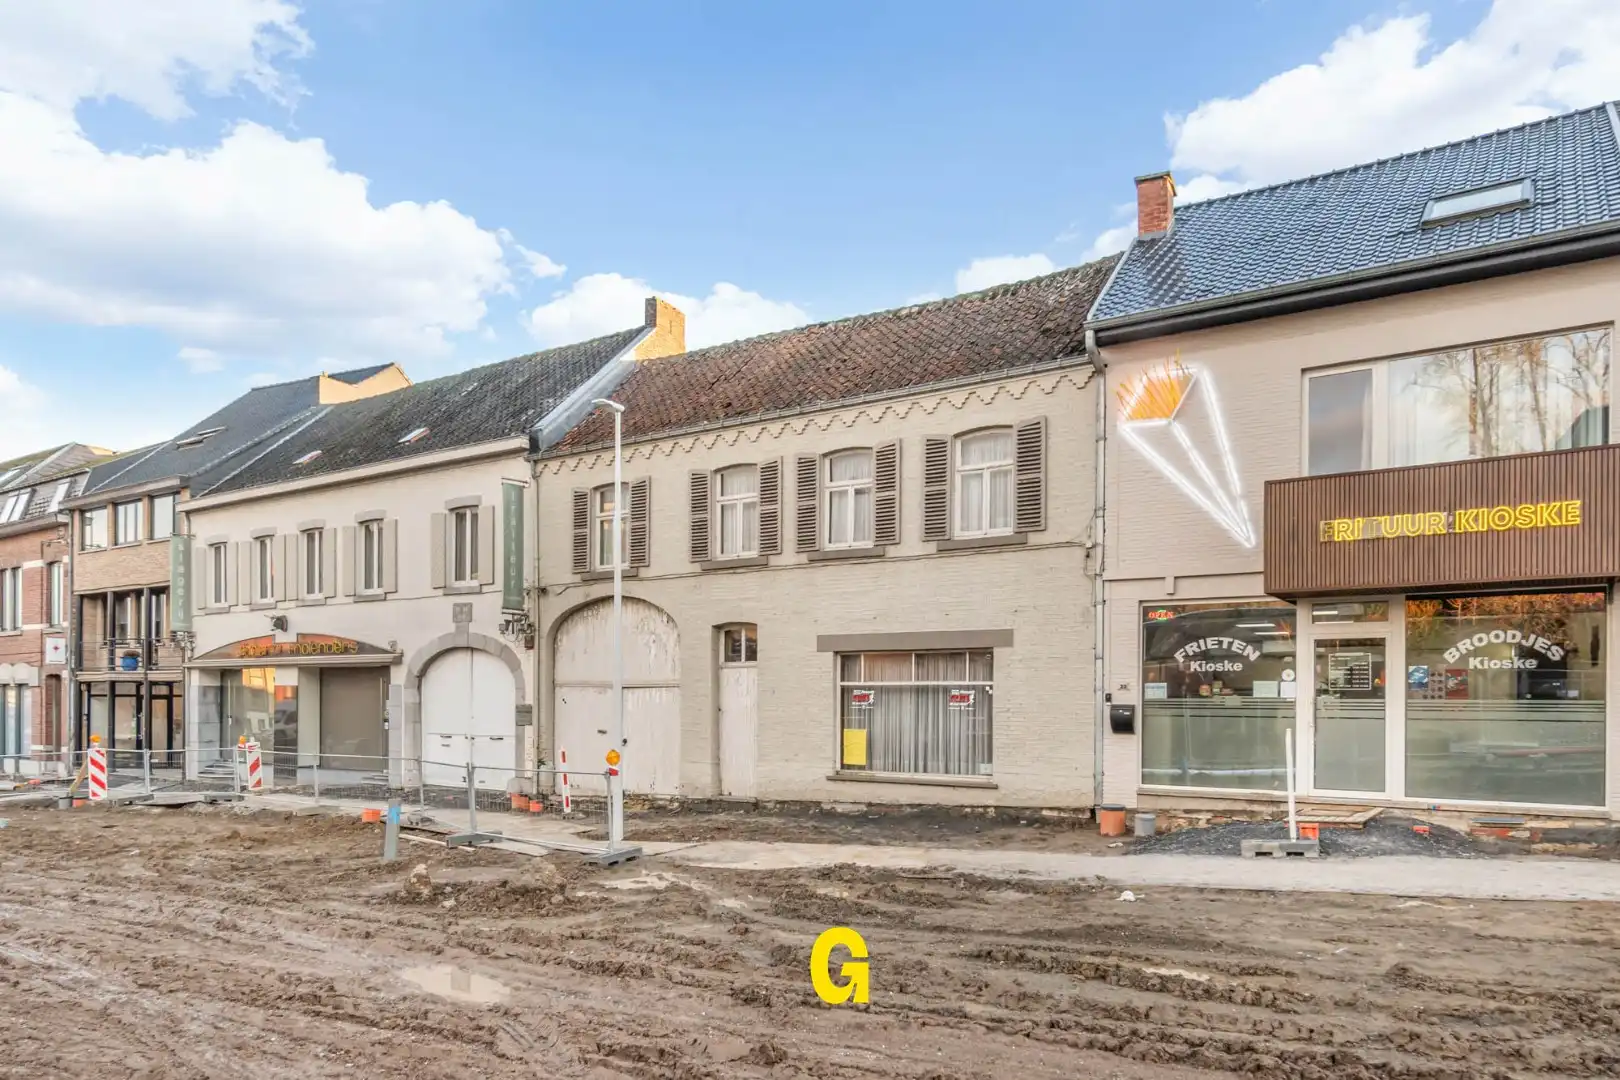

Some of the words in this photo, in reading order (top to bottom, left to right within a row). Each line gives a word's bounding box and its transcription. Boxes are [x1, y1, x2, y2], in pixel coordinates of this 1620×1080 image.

[1320, 512, 1448, 542] FRITUUR
[1455, 500, 1581, 532] KIOSKE
[1173, 636, 1261, 662] FRIETEN
[1442, 629, 1564, 664] BROODJES
[1190, 660, 1243, 672] Kioske
[1468, 656, 1538, 669] Kioske
